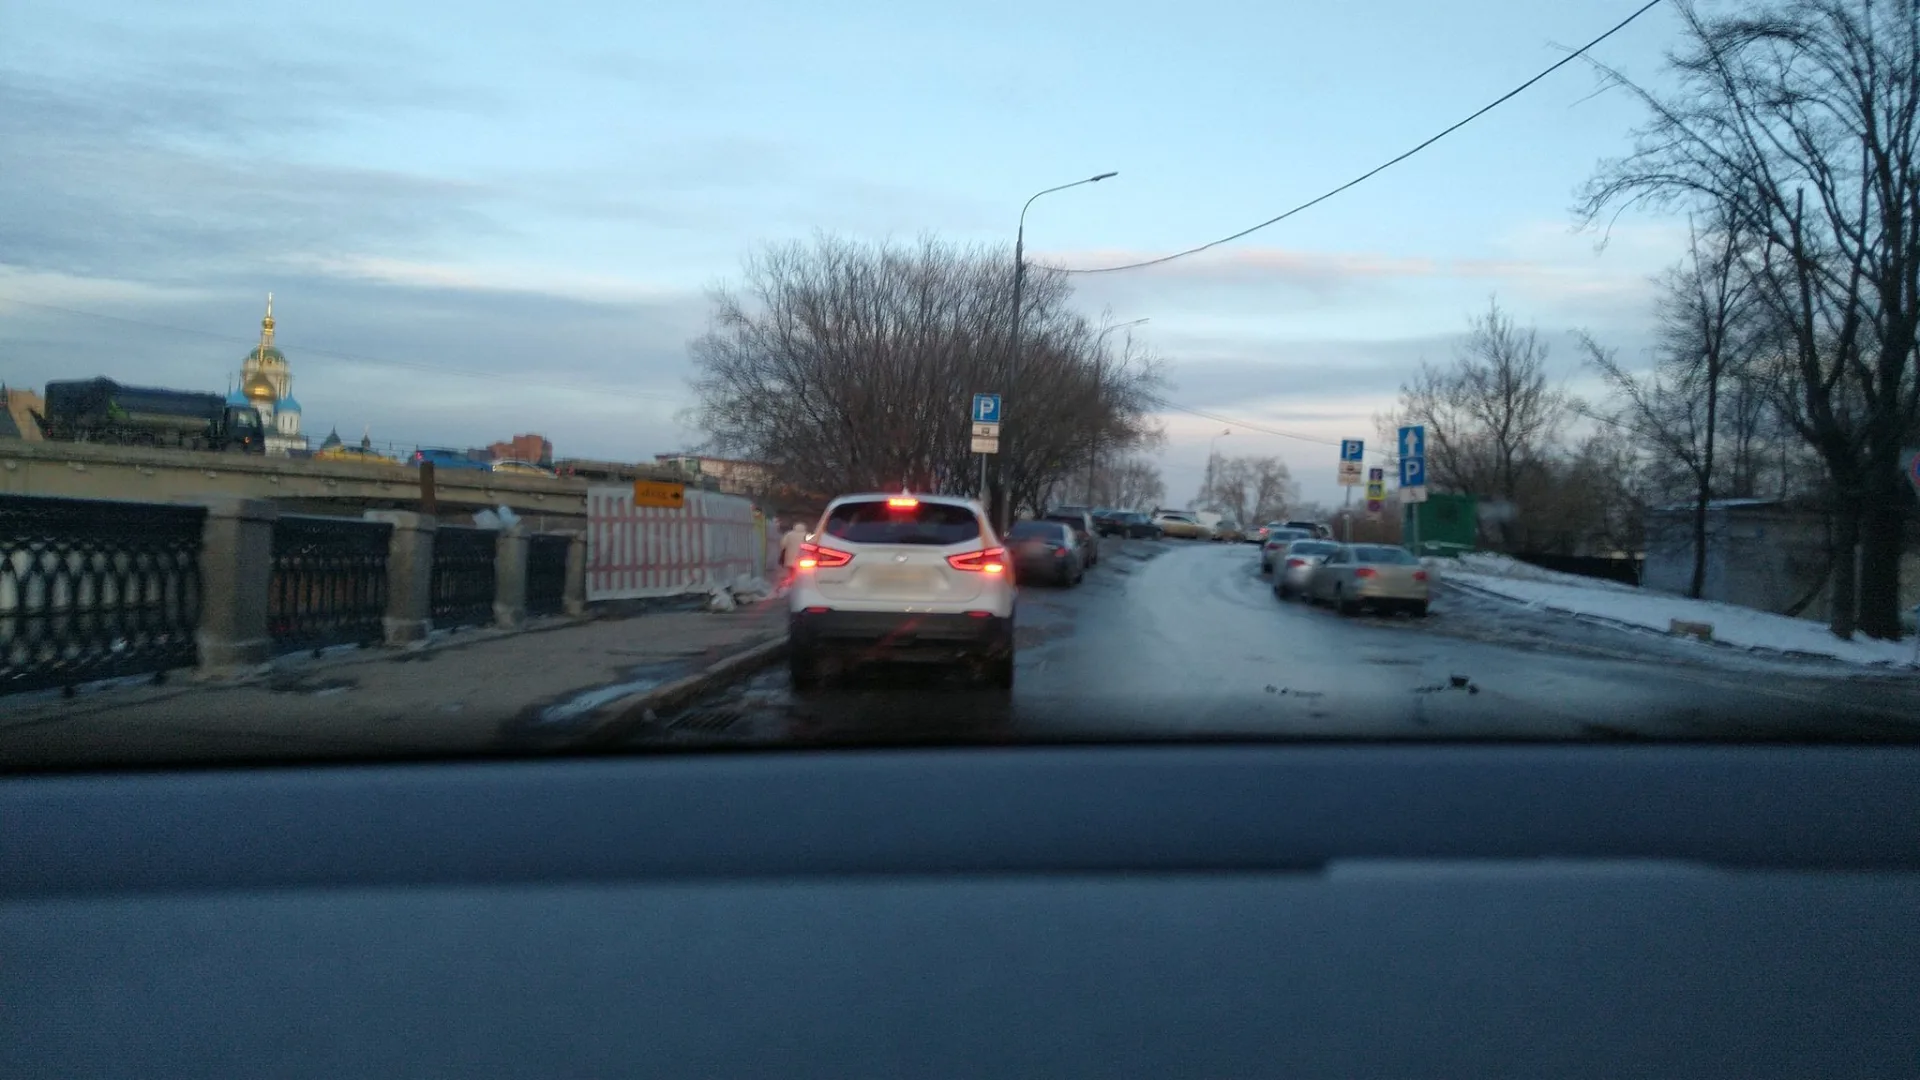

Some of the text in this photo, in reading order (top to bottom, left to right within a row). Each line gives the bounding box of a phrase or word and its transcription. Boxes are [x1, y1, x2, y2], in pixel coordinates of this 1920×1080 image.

[980, 397, 994, 420] P
[1346, 442, 1359, 460] P
[1406, 461, 1420, 483] P
